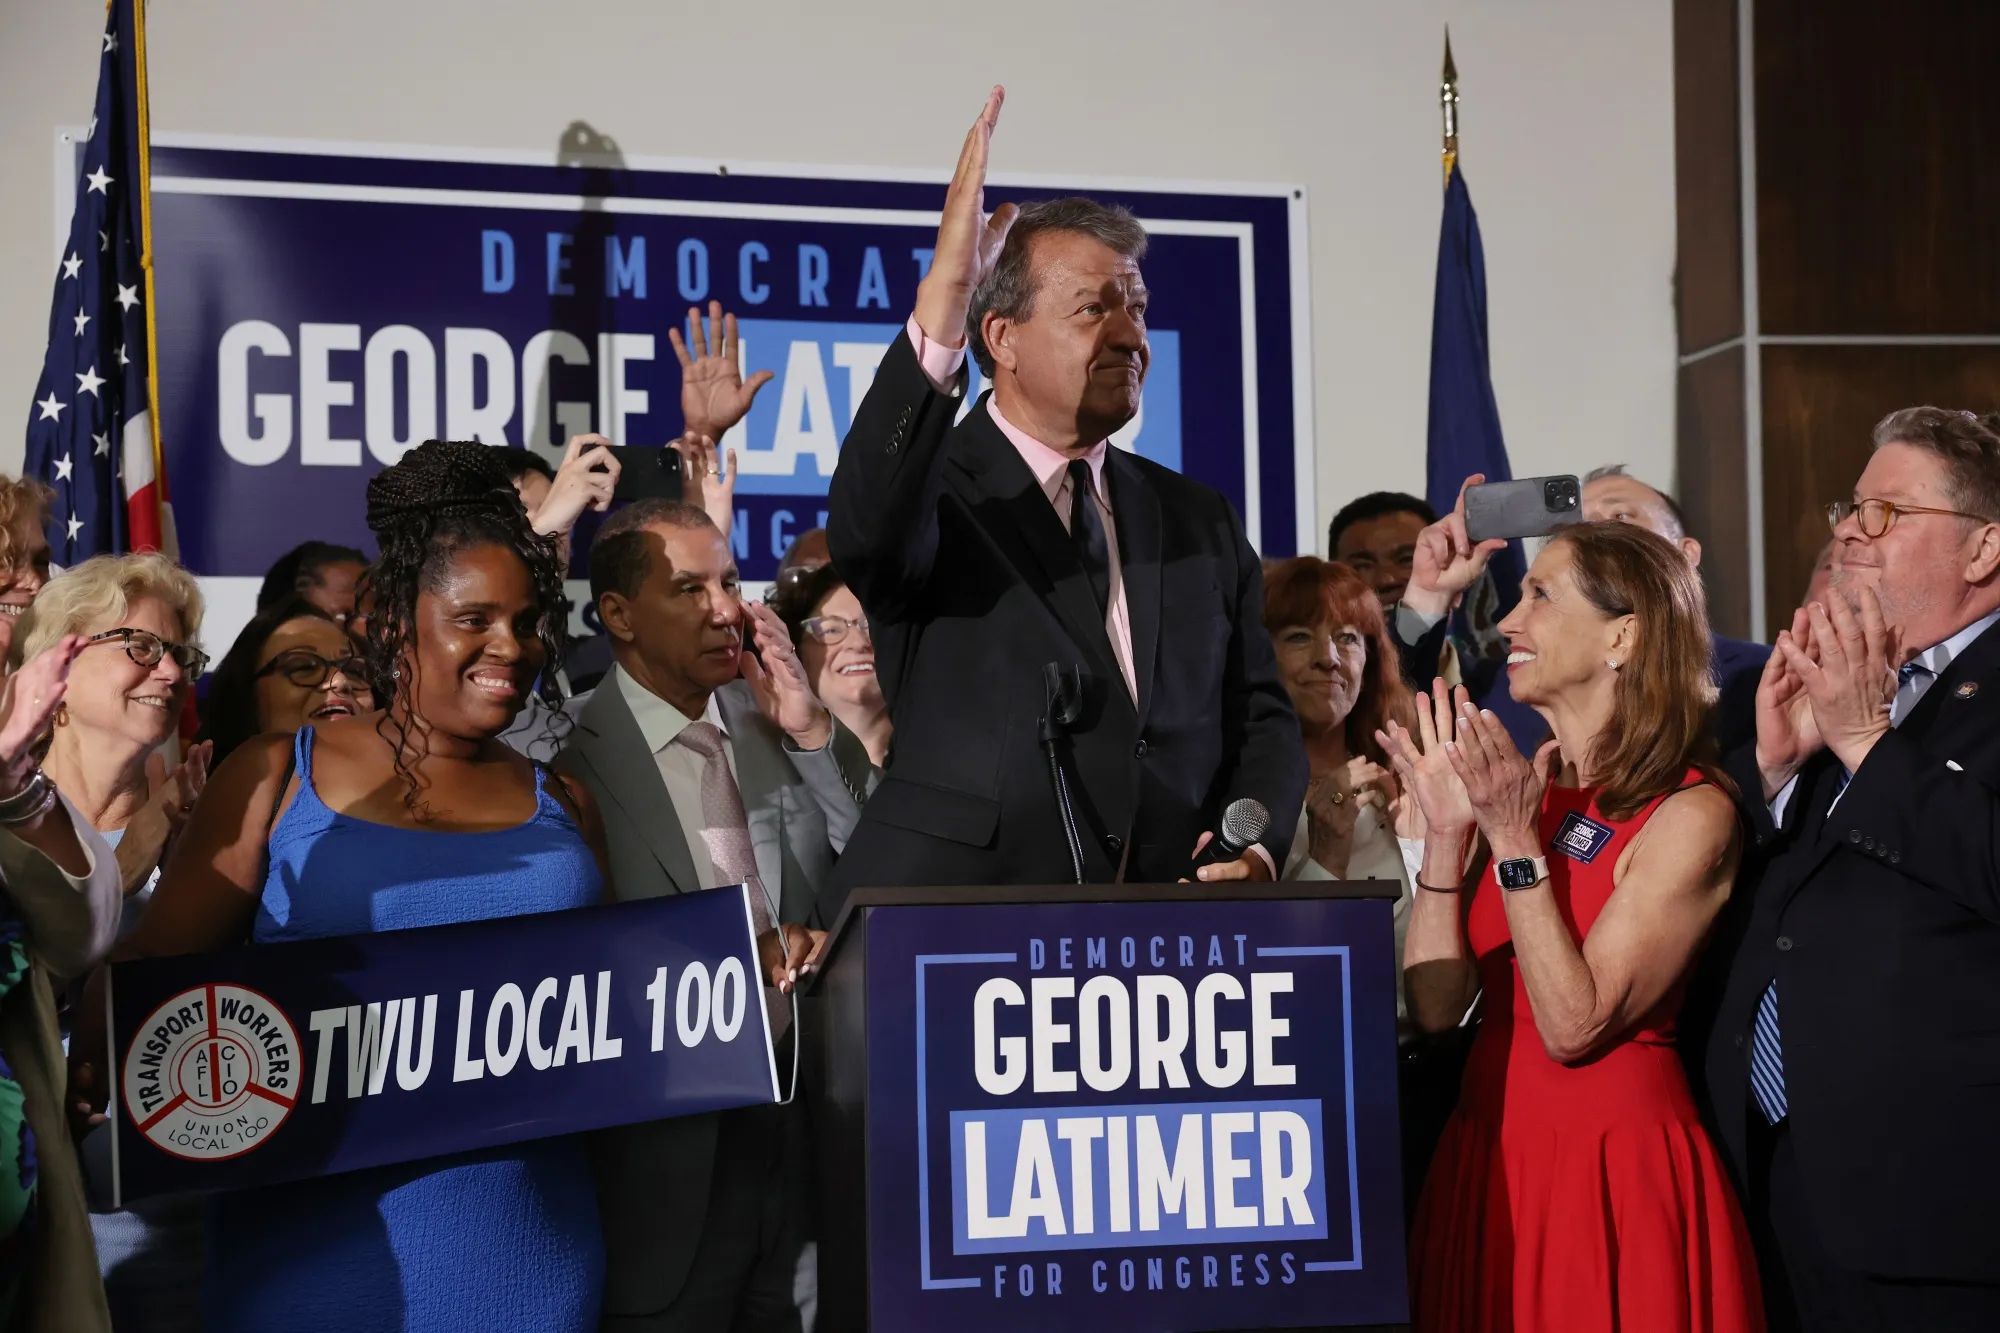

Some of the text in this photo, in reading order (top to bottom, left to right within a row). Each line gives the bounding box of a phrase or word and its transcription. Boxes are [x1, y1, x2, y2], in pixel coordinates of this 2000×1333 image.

[1029, 934, 1248, 970] DEMOCRAT
[137, 997, 290, 1113] TRANSPORT WORKERS
[308, 955, 747, 1104] TWU LOCAL 100
[973, 971, 1297, 1095] GEORGE
[168, 1117, 269, 1150] LOCAL 100
[185, 1115, 248, 1136] UNION
[964, 1110, 1316, 1239] LATIMER
[994, 1252, 1296, 1298] FOR CONGRESS
